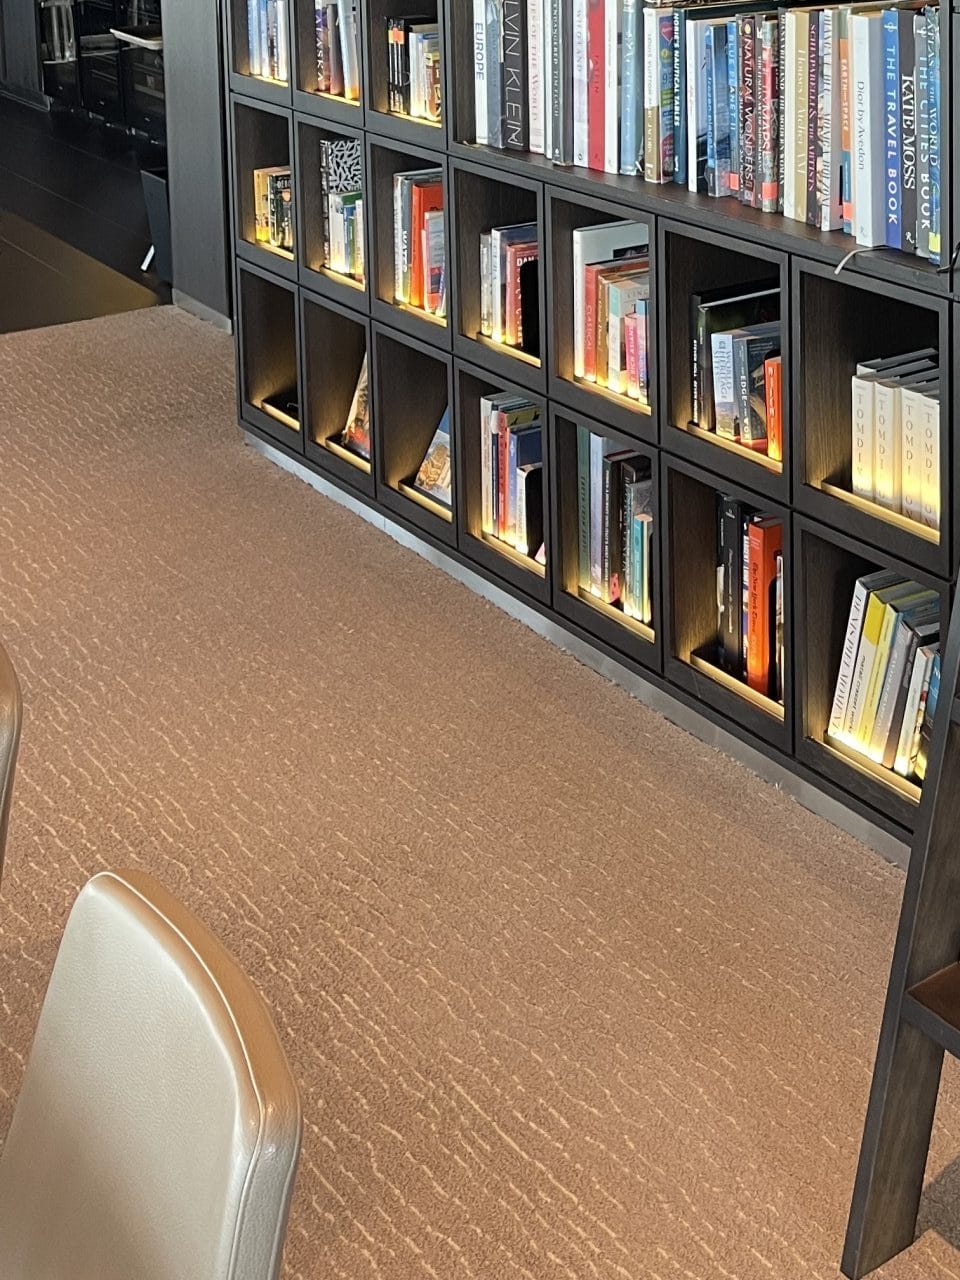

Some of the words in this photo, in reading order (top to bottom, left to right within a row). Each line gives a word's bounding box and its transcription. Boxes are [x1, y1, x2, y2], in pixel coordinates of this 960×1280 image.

[474, 22, 484, 80] EUROPE
[673, 50, 681, 94] NAUTICAL
[743, 37, 754, 102] NATURAL
[886, 45, 897, 80] THE
[919, 56, 929, 89] THE
[505, 67, 523, 147] KLEIN
[673, 96, 681, 127] TABLES
[857, 81, 866, 106] Dior
[857, 108, 866, 124] by
[902, 74, 915, 128] KATE
[744, 107, 754, 180] WONDERS
[857, 125, 866, 170] Avedon
[887, 89, 897, 158] TRAVEL
[929, 108, 938, 166] WORLD
[808, 144, 816, 192] ARTISTS
[903, 134, 915, 189] MOSS
[888, 169, 899, 224] BOOK
[921, 173, 931, 229] BOOK
